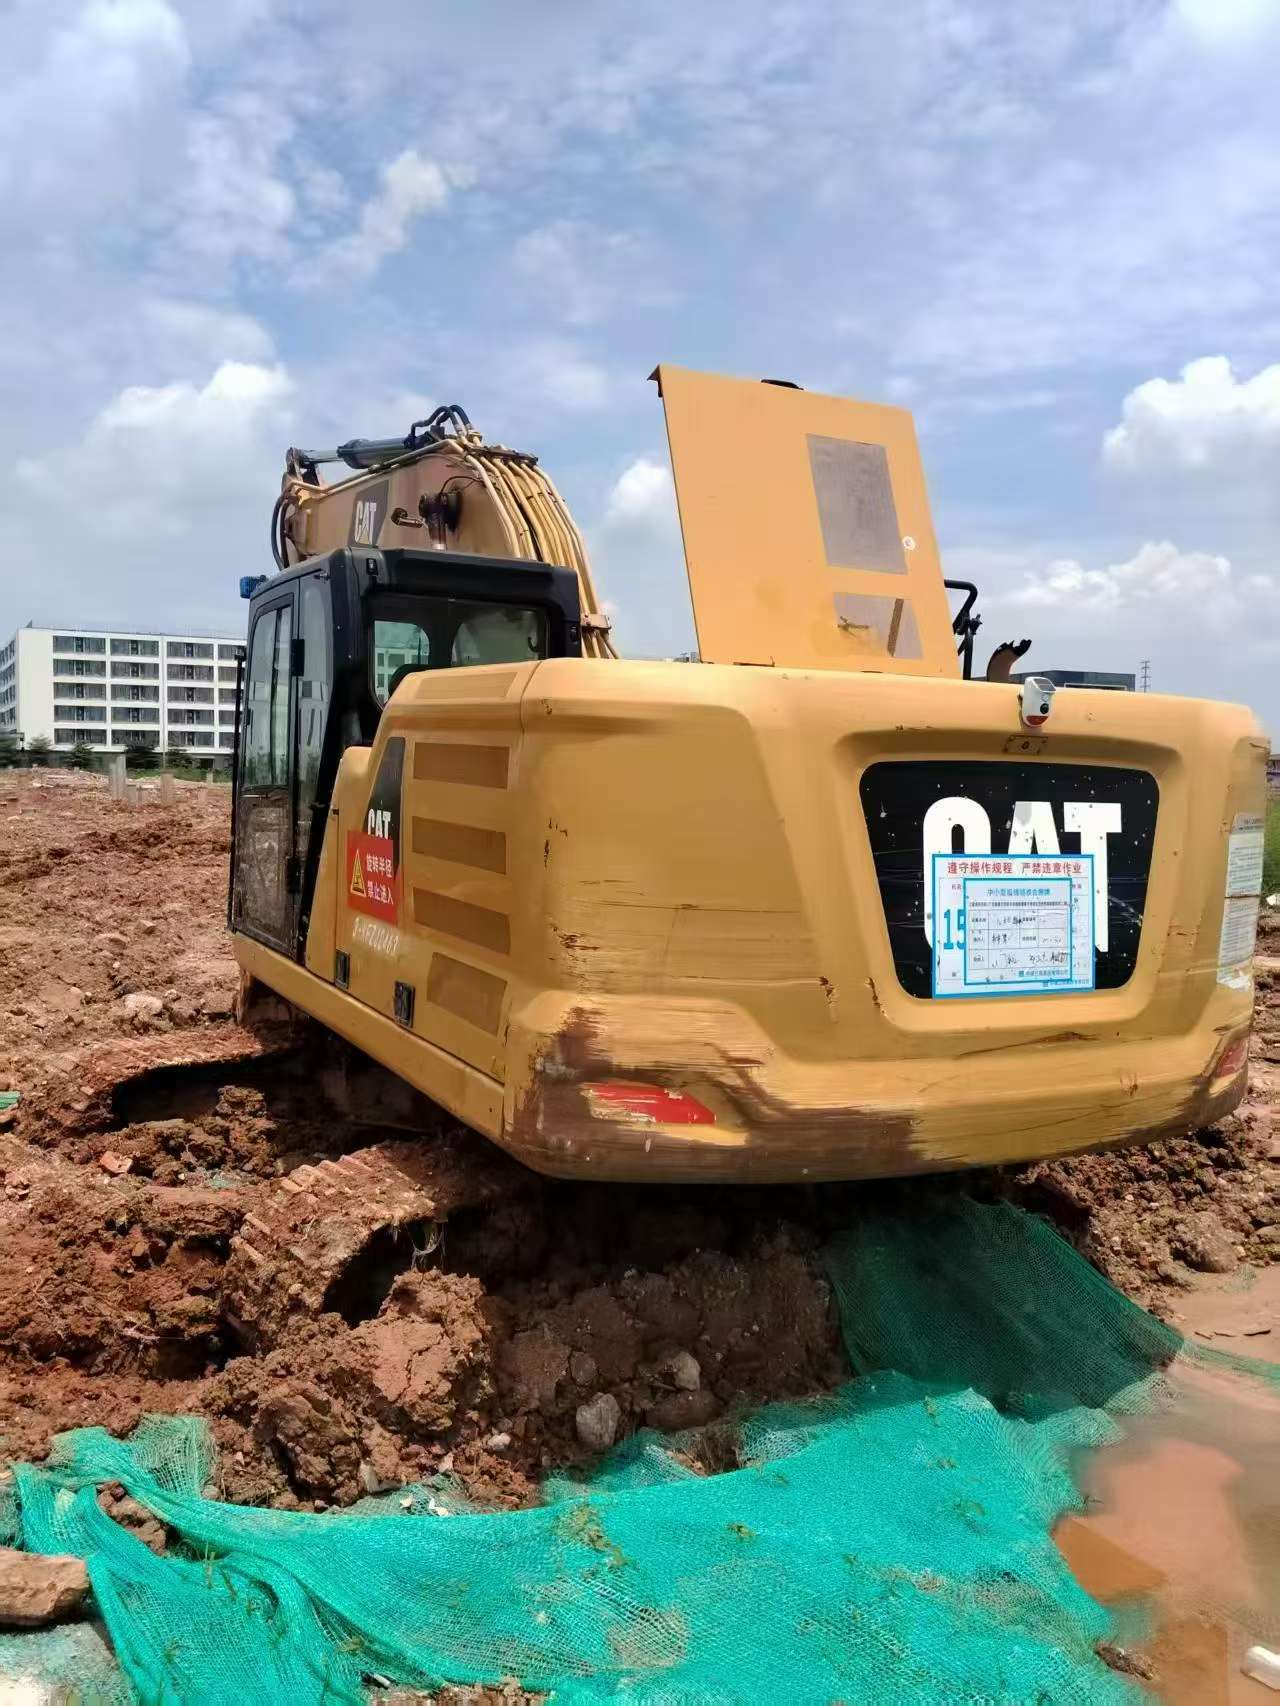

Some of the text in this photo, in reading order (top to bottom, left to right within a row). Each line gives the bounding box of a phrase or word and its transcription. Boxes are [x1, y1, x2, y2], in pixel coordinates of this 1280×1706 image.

[354, 500, 377, 545] CAT
[367, 808, 391, 840] CAT
[366, 852, 393, 879] 旋转半径
[947, 861, 1082, 874] 遵守操作规程 严禁违章作业
[367, 880, 394, 905] 禁止进入
